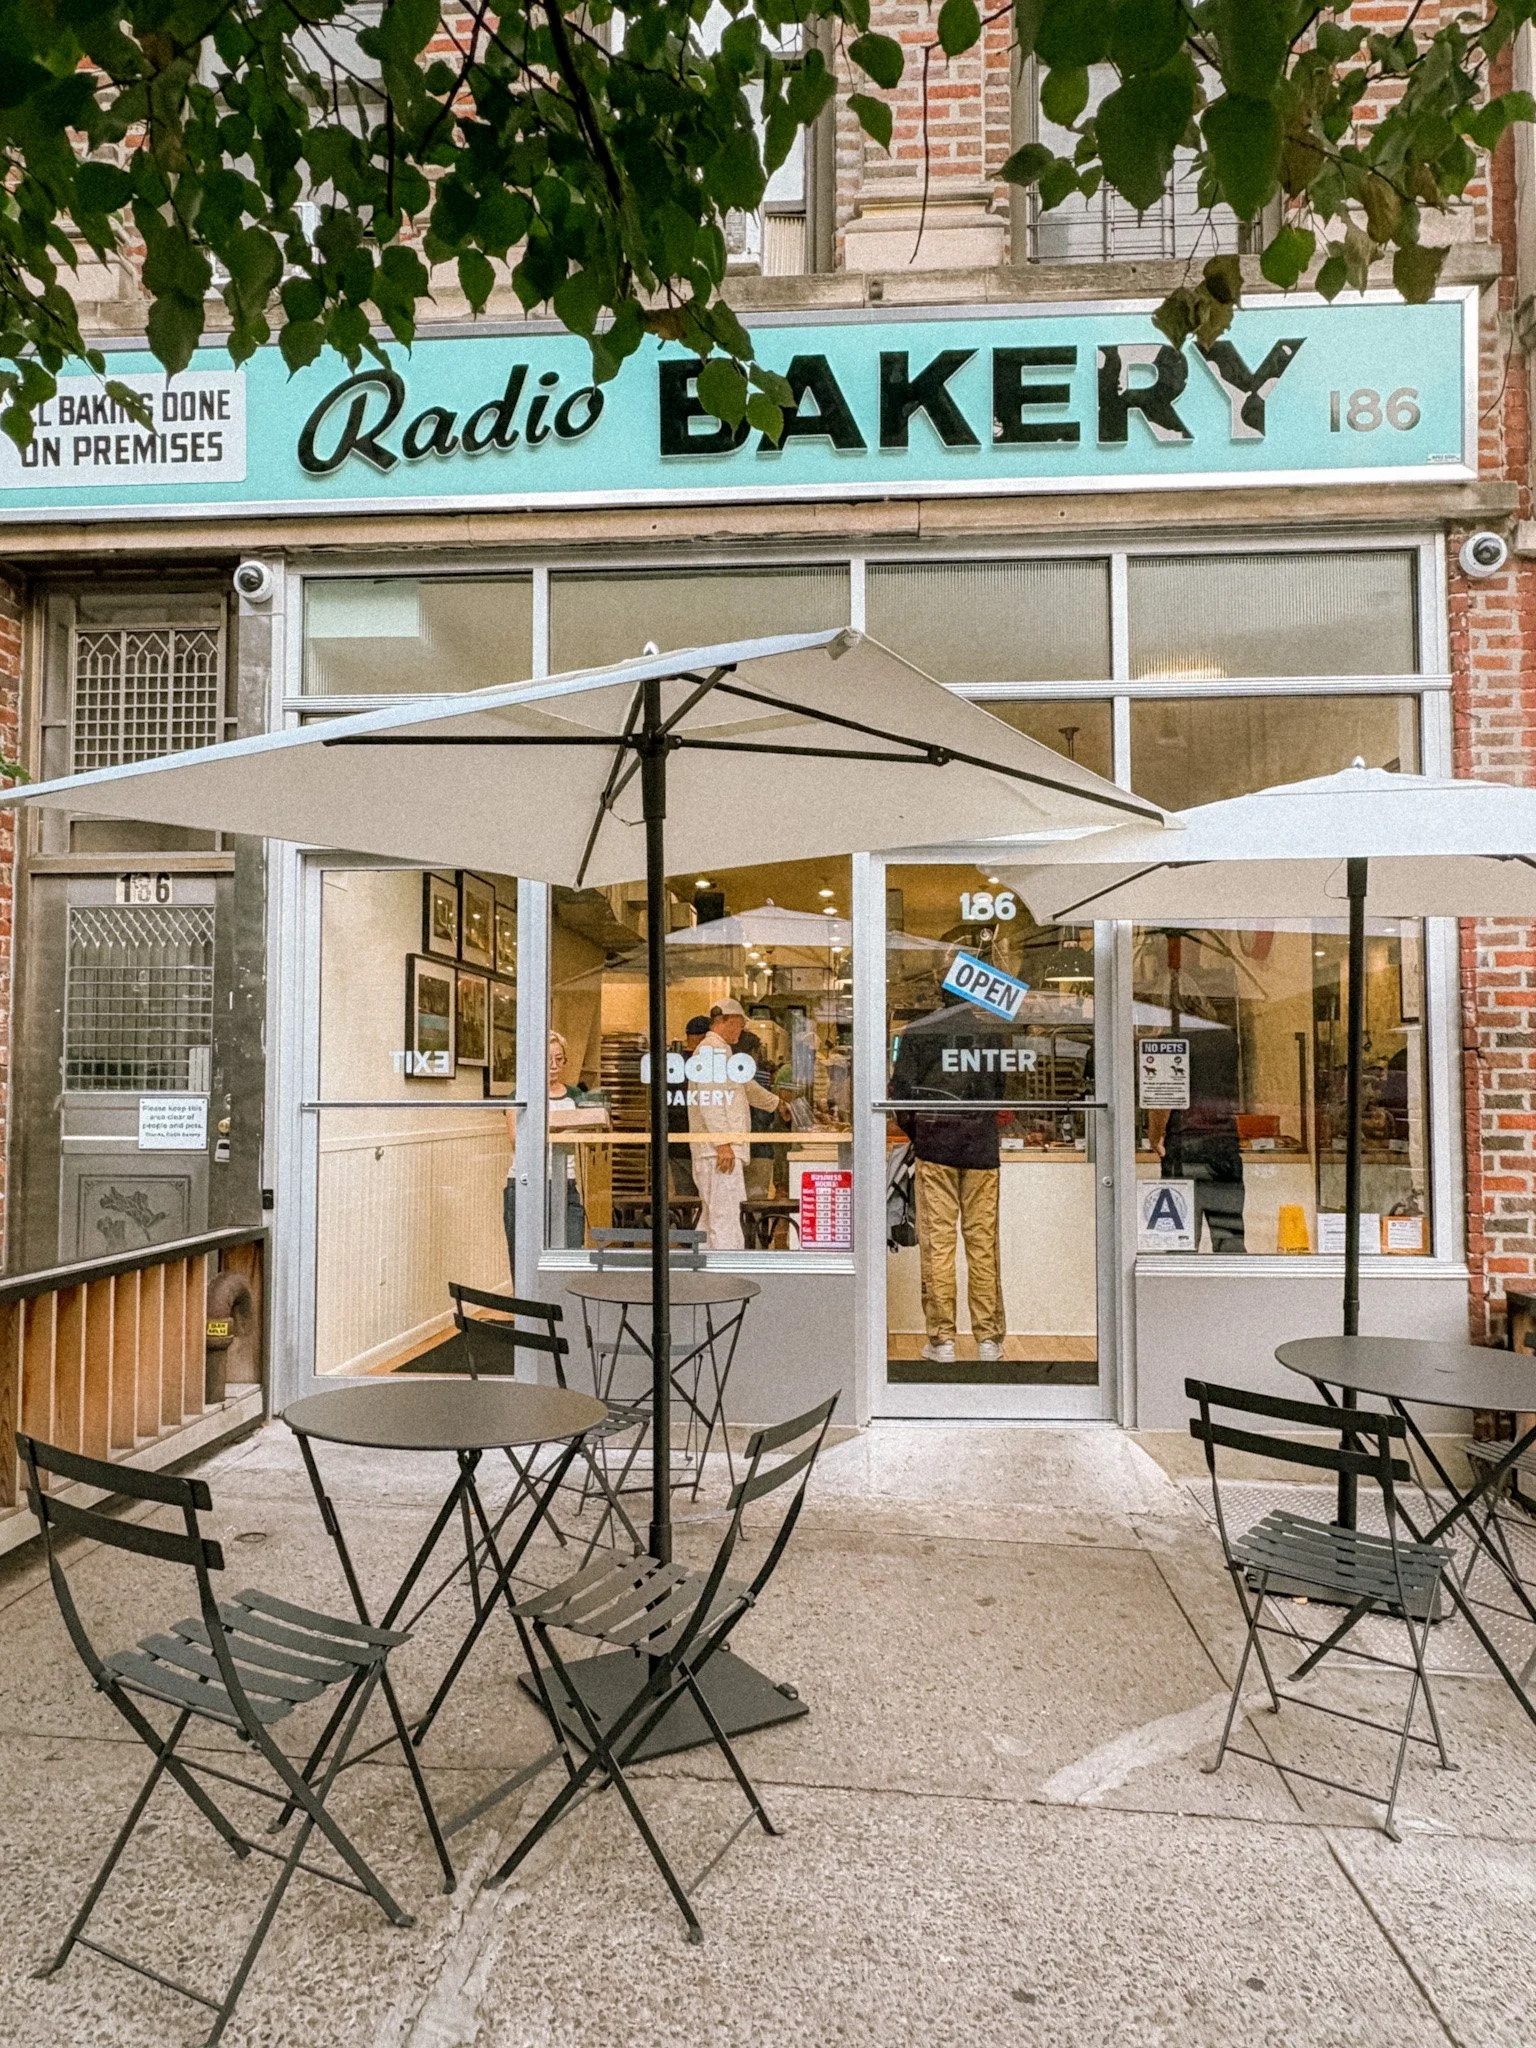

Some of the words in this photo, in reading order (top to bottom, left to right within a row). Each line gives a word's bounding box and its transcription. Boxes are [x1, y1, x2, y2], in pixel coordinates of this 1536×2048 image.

[162, 389, 231, 422] DONE
[298, 364, 605, 474] Radio
[657, 336, 1307, 457] BAKERY
[1329, 386, 1421, 433] 186
[21, 436, 61, 468] ON
[73, 431, 223, 466] PREMISES
[959, 891, 1017, 921] 186
[954, 963, 1021, 1012] OPEN
[941, 1048, 1038, 1073] ENTER
[1144, 1043, 1158, 1053] NO
[1160, 1043, 1184, 1053] PETS
[1146, 1188, 1185, 1230] A
